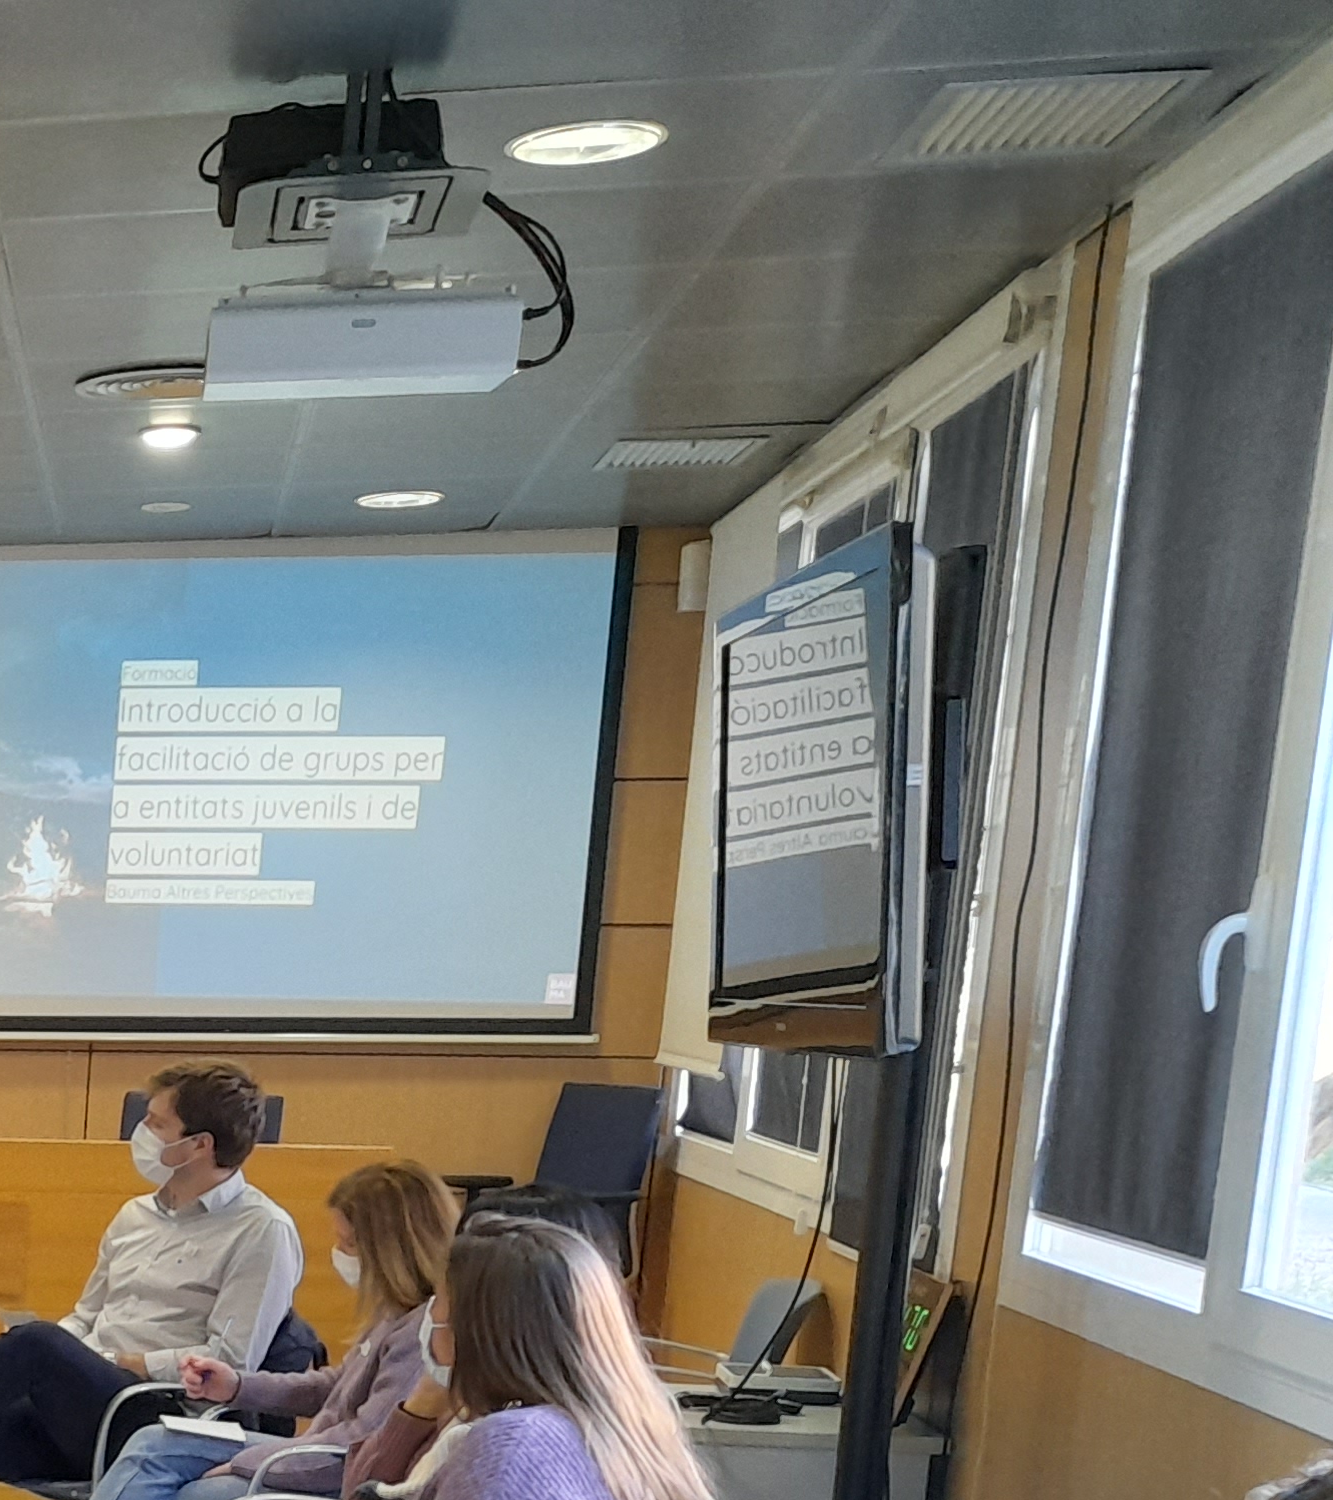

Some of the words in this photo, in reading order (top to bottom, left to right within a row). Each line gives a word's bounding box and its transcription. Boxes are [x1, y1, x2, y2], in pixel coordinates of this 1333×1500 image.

[121, 664, 197, 681] Formació
[120, 696, 276, 724] Introducció
[286, 702, 304, 724] a
[313, 695, 339, 724] la
[116, 744, 251, 773] facilitació
[259, 745, 295, 773] de
[303, 751, 385, 778] grups
[393, 751, 445, 778] per
[112, 799, 130, 821] a
[138, 795, 245, 821] entitats
[251, 791, 357, 826] juvenils
[365, 793, 374, 821] i
[380, 794, 418, 822] de
[109, 840, 260, 868] voluntariat
[165, 884, 212, 900] Altres
